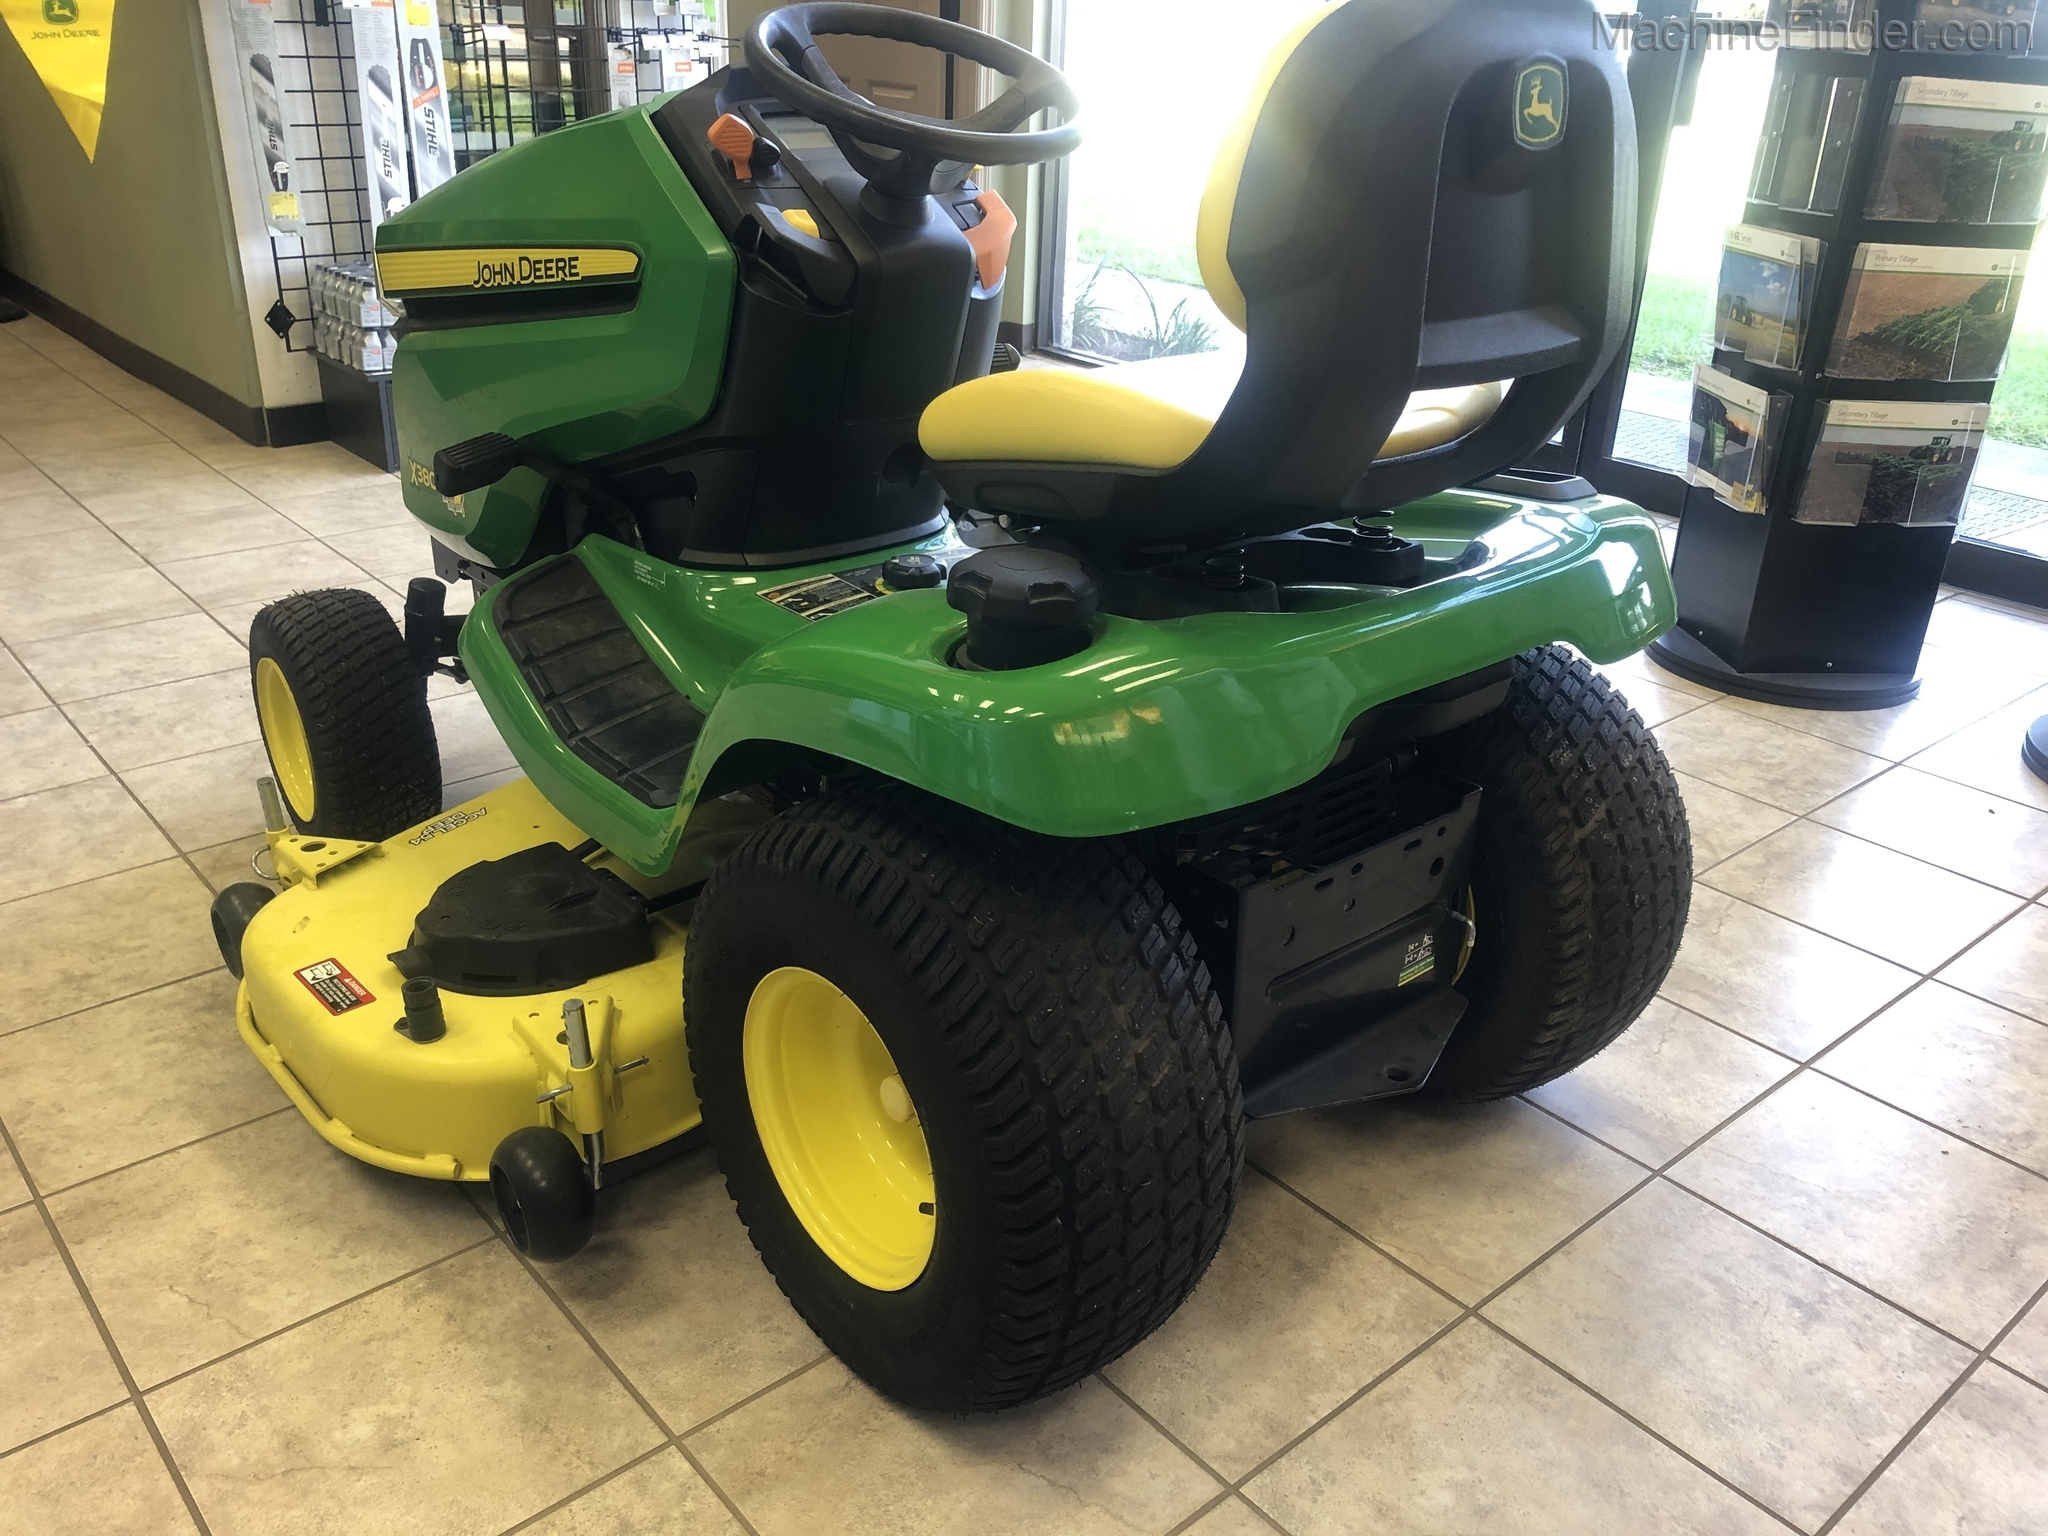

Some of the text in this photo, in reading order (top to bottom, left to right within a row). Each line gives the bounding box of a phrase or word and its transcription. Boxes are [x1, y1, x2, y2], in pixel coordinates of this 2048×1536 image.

[31, 29, 100, 40] JOHN DEERE
[1917, 87, 1970, 99] Secondary Tillage
[269, 119, 279, 151] STIHL
[424, 106, 440, 158] STIHL
[381, 138, 393, 178] STIHL
[473, 256, 580, 285] JOHN DEERE
[1875, 255, 1918, 264] Primary Tillage
[1838, 410, 1888, 420] Secondary Tillage
[423, 811, 466, 837] DEEP
[433, 807, 487, 835] ACCEL
[347, 980, 367, 996] DANGER
